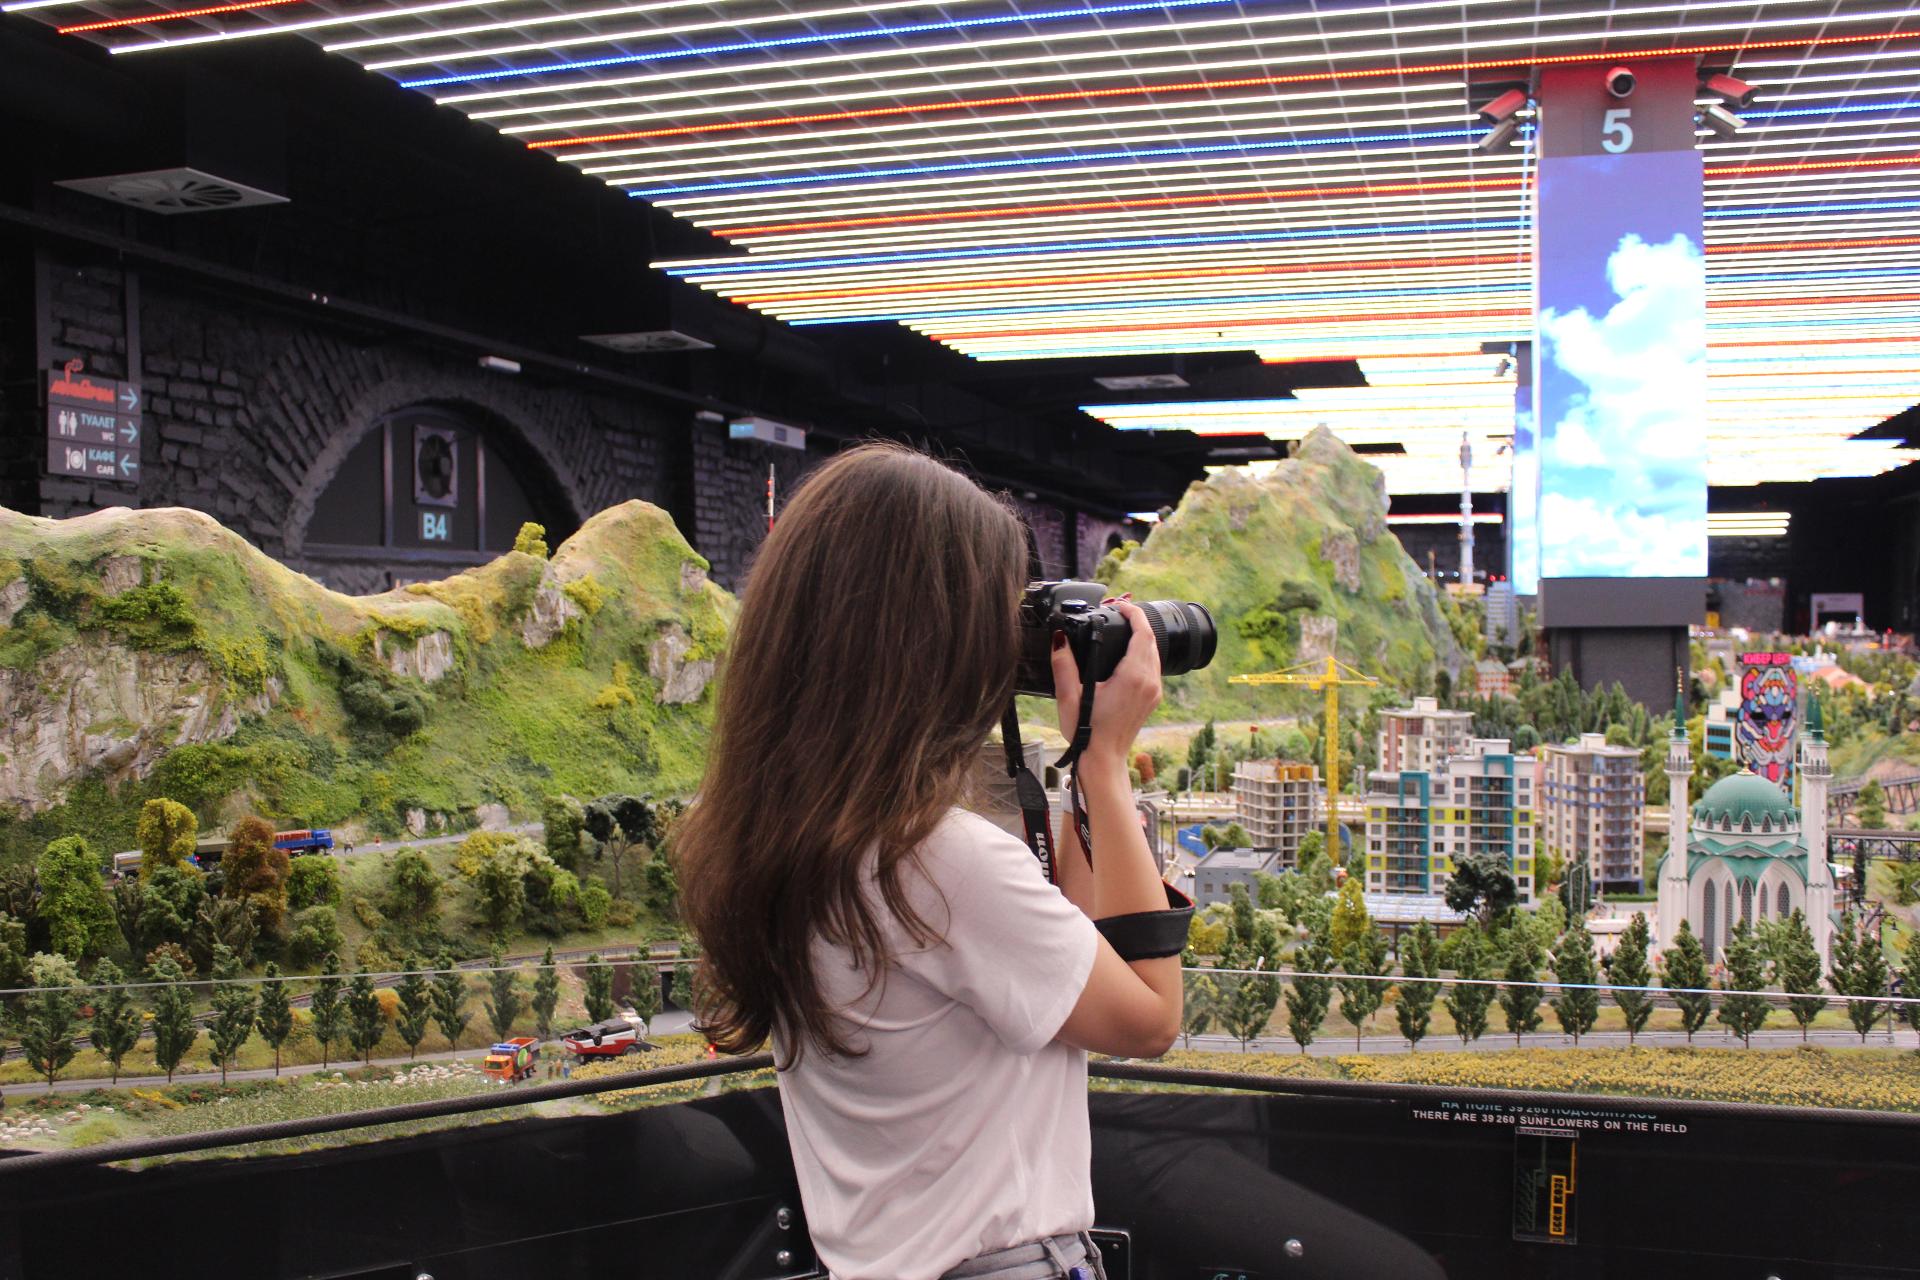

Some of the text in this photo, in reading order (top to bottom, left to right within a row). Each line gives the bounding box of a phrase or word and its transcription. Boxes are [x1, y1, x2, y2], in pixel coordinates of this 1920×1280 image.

[1601, 108, 1633, 153] 5
[81, 413, 116, 429] ТУАЛЕТ
[102, 431, 115, 442] WC
[89, 448, 115, 463] КАФЕ
[96, 464, 115, 476] CAFE
[423, 512, 447, 540] B4
[1413, 1110, 1450, 1121] THERE
[1454, 1112, 1477, 1122] ARE
[1520, 1116, 1599, 1129] SUNFLOWERS
[1604, 1120, 1621, 1130] ON
[1626, 1121, 1649, 1132] THE
[1653, 1123, 1688, 1134] FIELD
